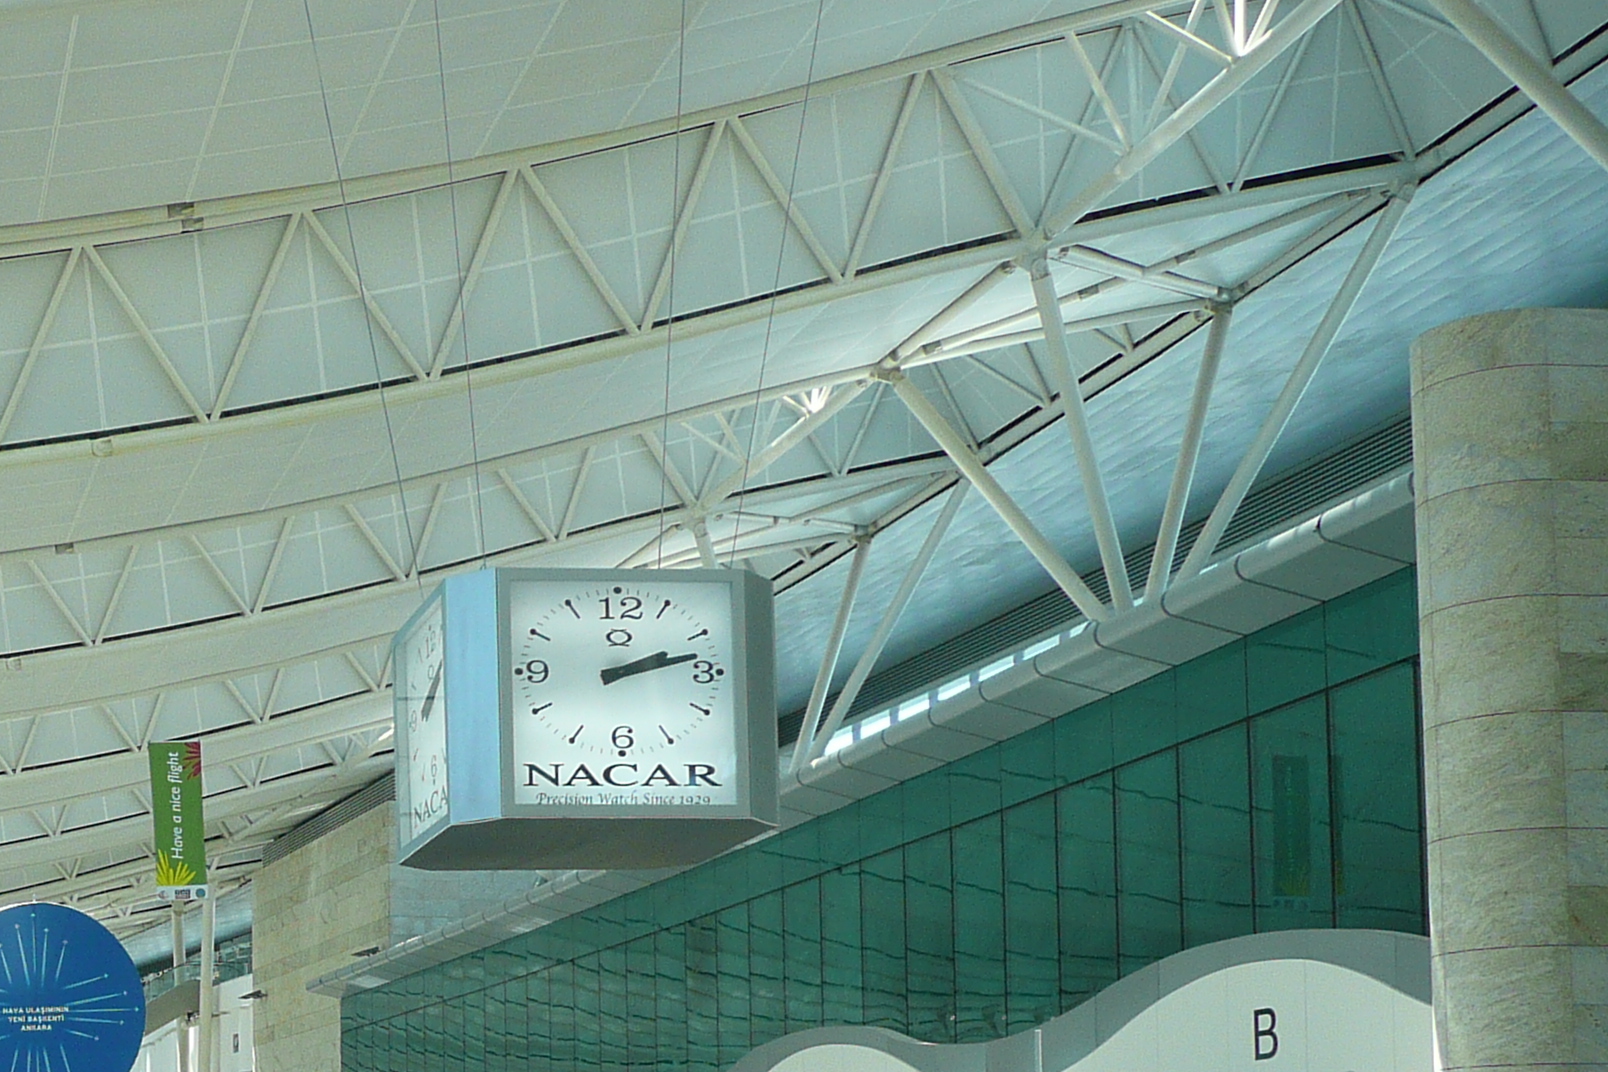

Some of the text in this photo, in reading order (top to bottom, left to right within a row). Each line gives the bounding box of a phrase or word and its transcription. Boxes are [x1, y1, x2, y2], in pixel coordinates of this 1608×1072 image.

[598, 597, 643, 620] 12
[526, 660, 549, 684] 9
[693, 660, 715, 684] 3
[612, 726, 634, 749] 6
[431, 755, 437, 778] 6
[523, 763, 722, 787] NACAR
[167, 752, 184, 859] Have a nice flight
[413, 785, 448, 829] NACA
[536, 790, 710, 805] Precision Watch Since 1929
[1253, 1006, 1280, 1061] B
